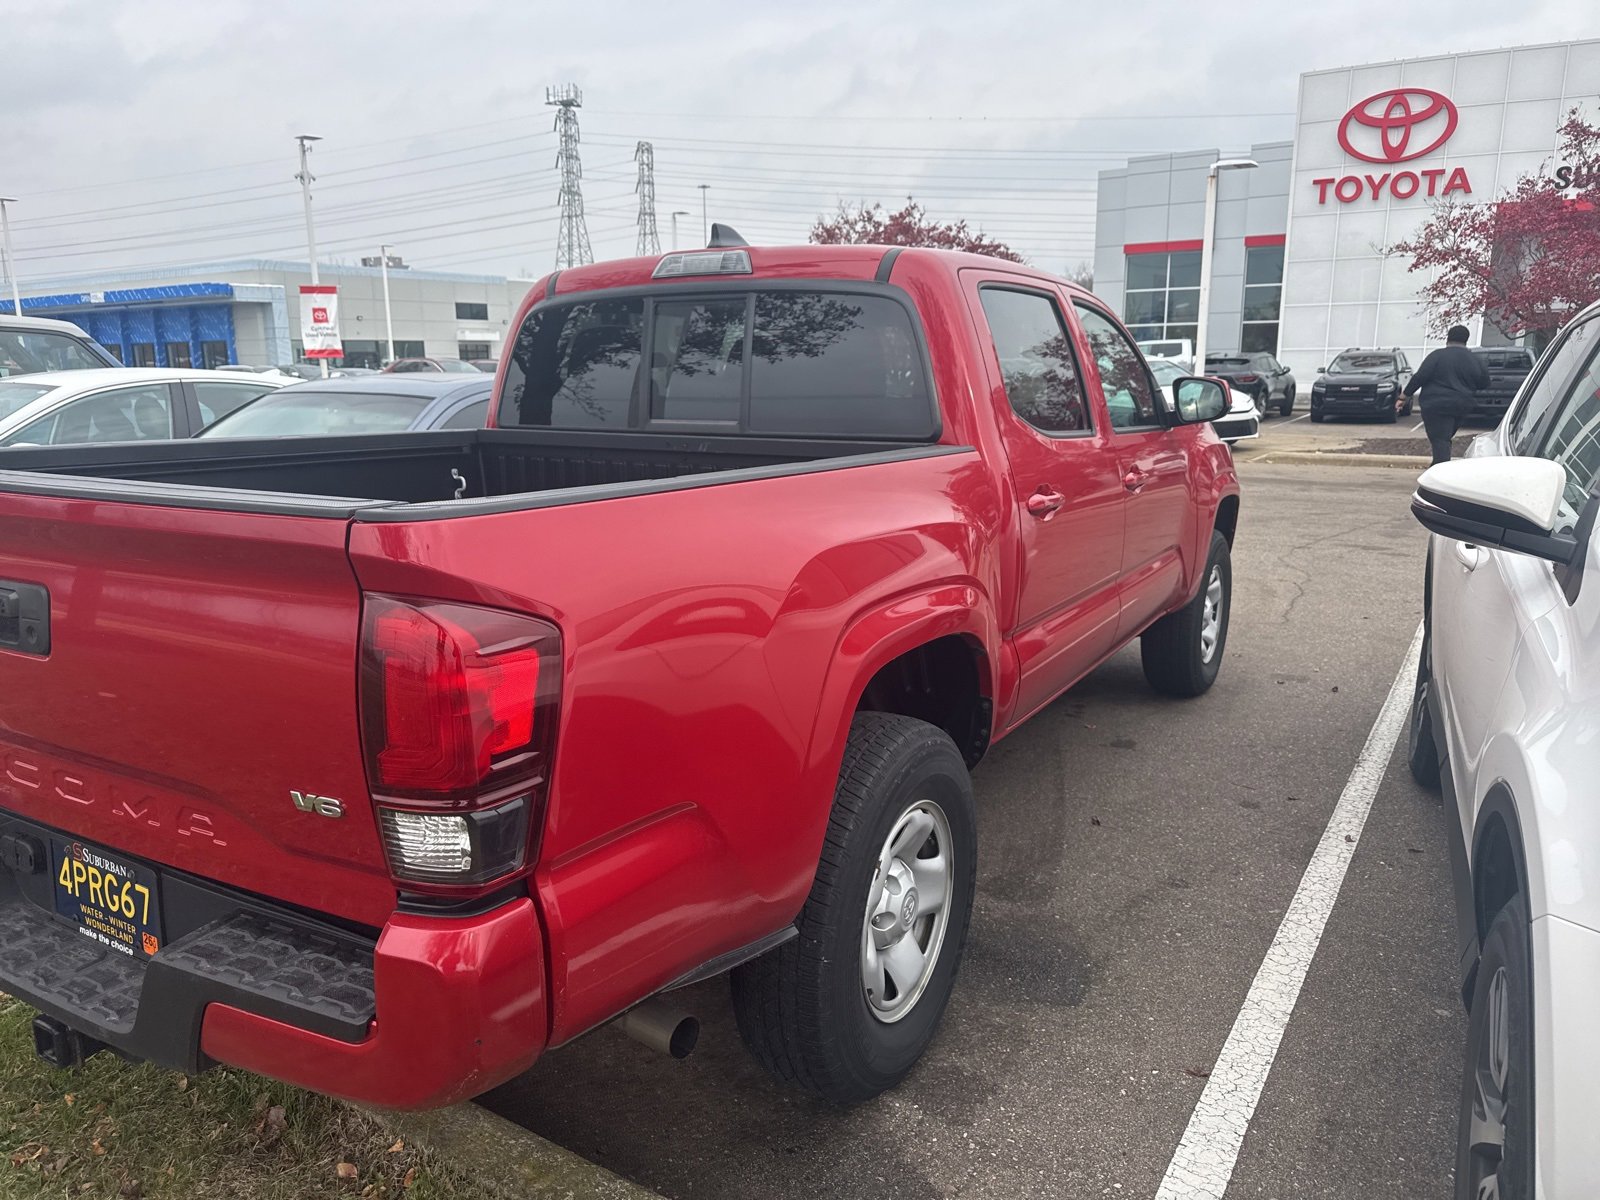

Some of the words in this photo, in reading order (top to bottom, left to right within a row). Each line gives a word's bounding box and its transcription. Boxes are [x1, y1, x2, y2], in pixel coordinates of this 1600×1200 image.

[1312, 167, 1473, 205] TOYOTA
[289, 790, 342, 819] V6
[82, 847, 127, 877] SUBURBAN
[59, 856, 150, 926] 4PRG67
[80, 903, 104, 920] WATER
[108, 915, 136, 935] WINTER
[84, 916, 134, 945] WONDERLAND
[79, 926, 97, 940] make
[98, 933, 110, 945] the
[110, 940, 134, 956] choice
